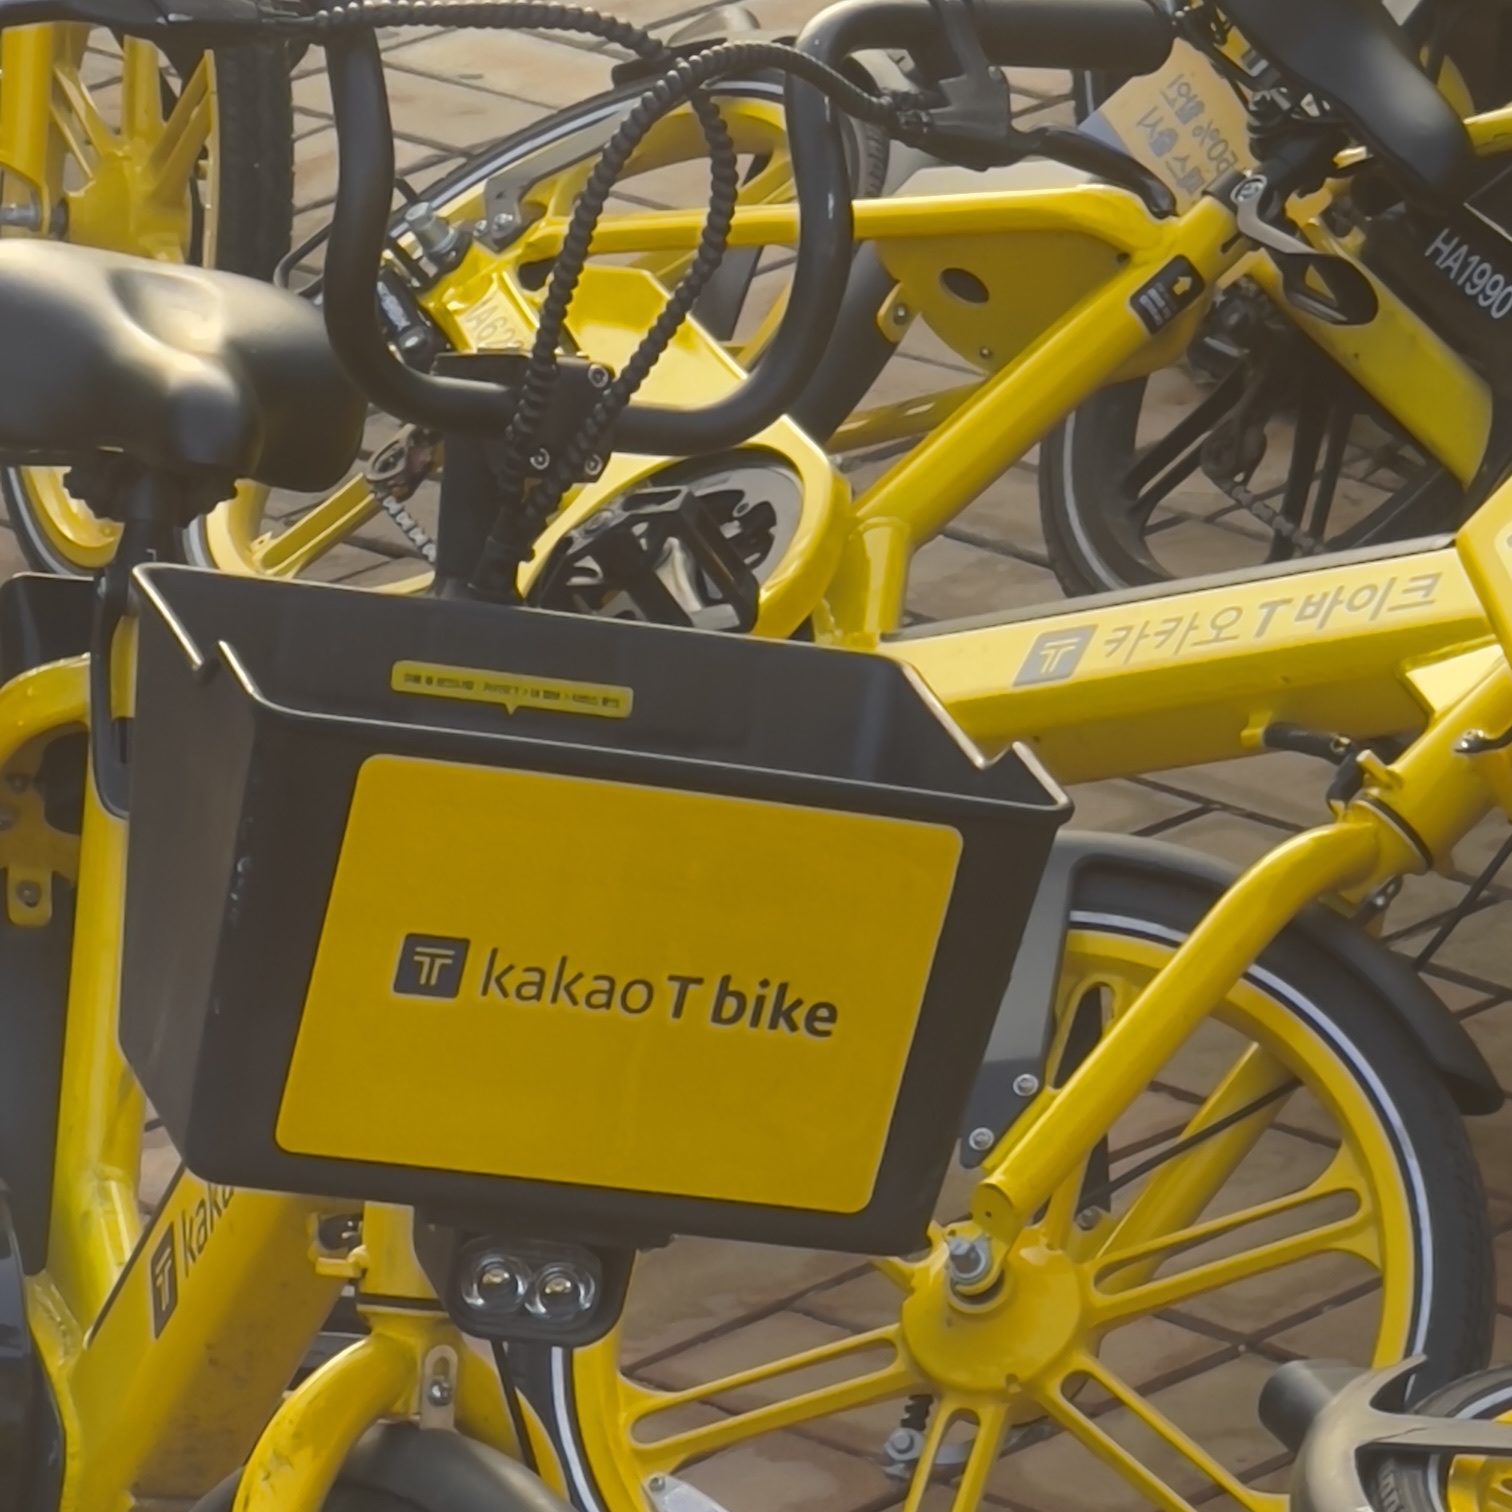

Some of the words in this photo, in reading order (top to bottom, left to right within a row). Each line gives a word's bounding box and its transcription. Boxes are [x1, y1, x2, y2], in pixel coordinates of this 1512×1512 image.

[480, 946, 655, 1015] kakao
[667, 974, 704, 1020] T
[710, 973, 839, 1038] bike
